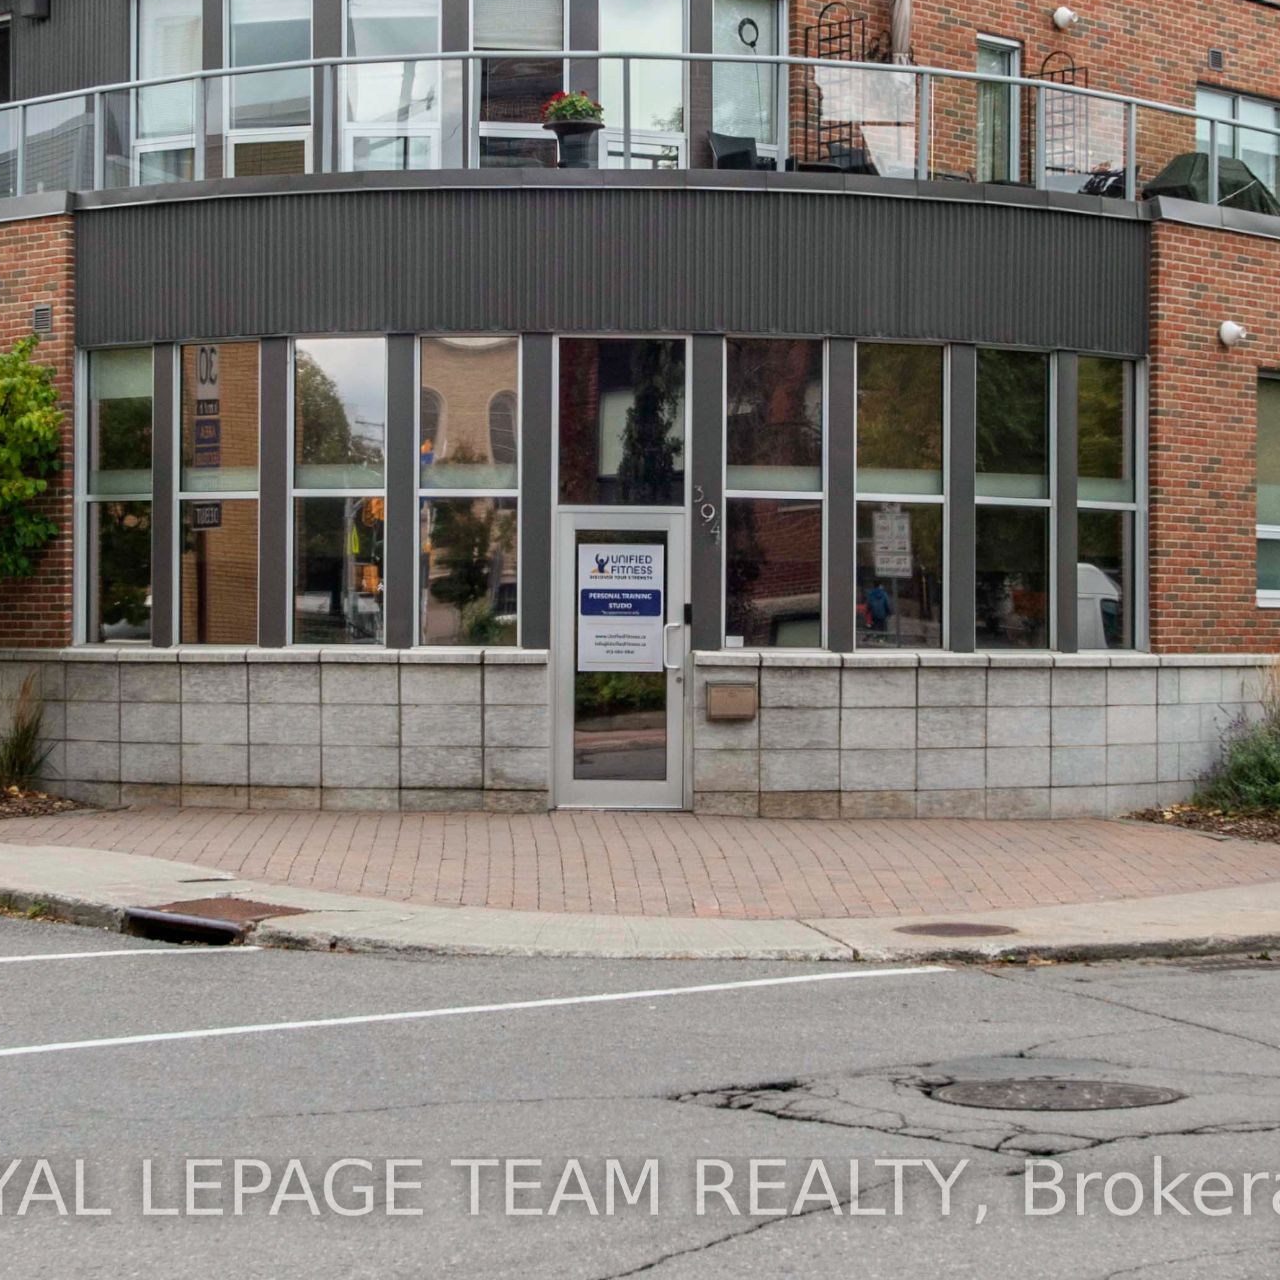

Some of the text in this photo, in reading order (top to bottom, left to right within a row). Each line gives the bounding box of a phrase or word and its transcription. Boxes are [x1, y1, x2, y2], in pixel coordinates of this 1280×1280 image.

[611, 554, 653, 565] UNIFIED
[611, 565, 653, 575] FITNESS
[589, 592, 652, 600] PERSONAL TRAINING
